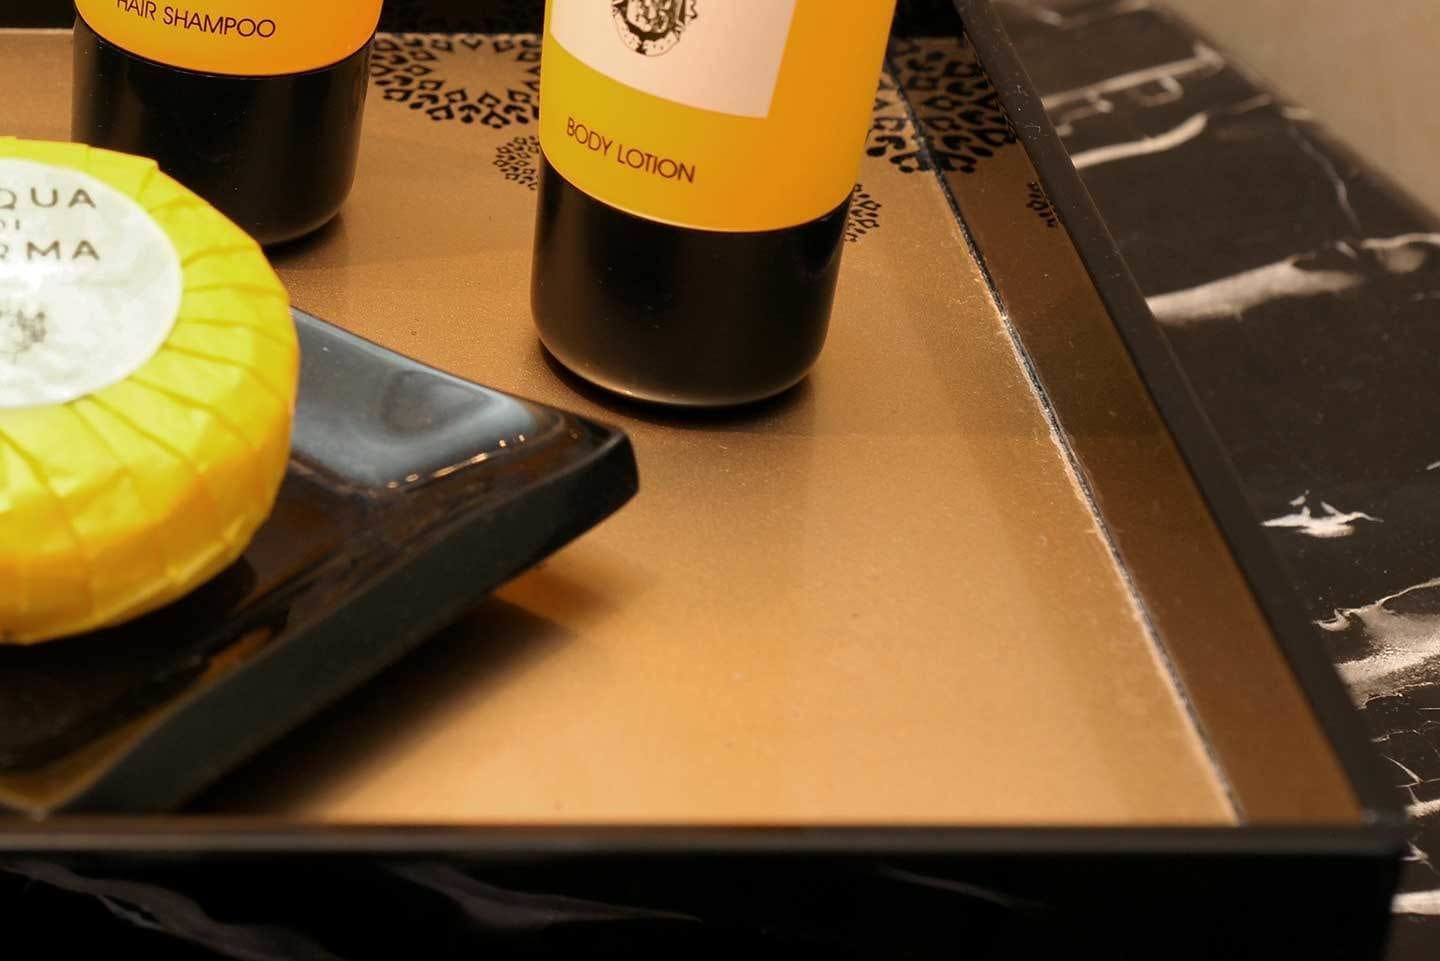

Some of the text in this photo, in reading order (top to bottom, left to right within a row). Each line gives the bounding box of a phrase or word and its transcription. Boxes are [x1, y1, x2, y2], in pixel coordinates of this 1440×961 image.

[163, 6, 276, 38] SHAMPOO
[566, 116, 696, 183] BODY LOTION
